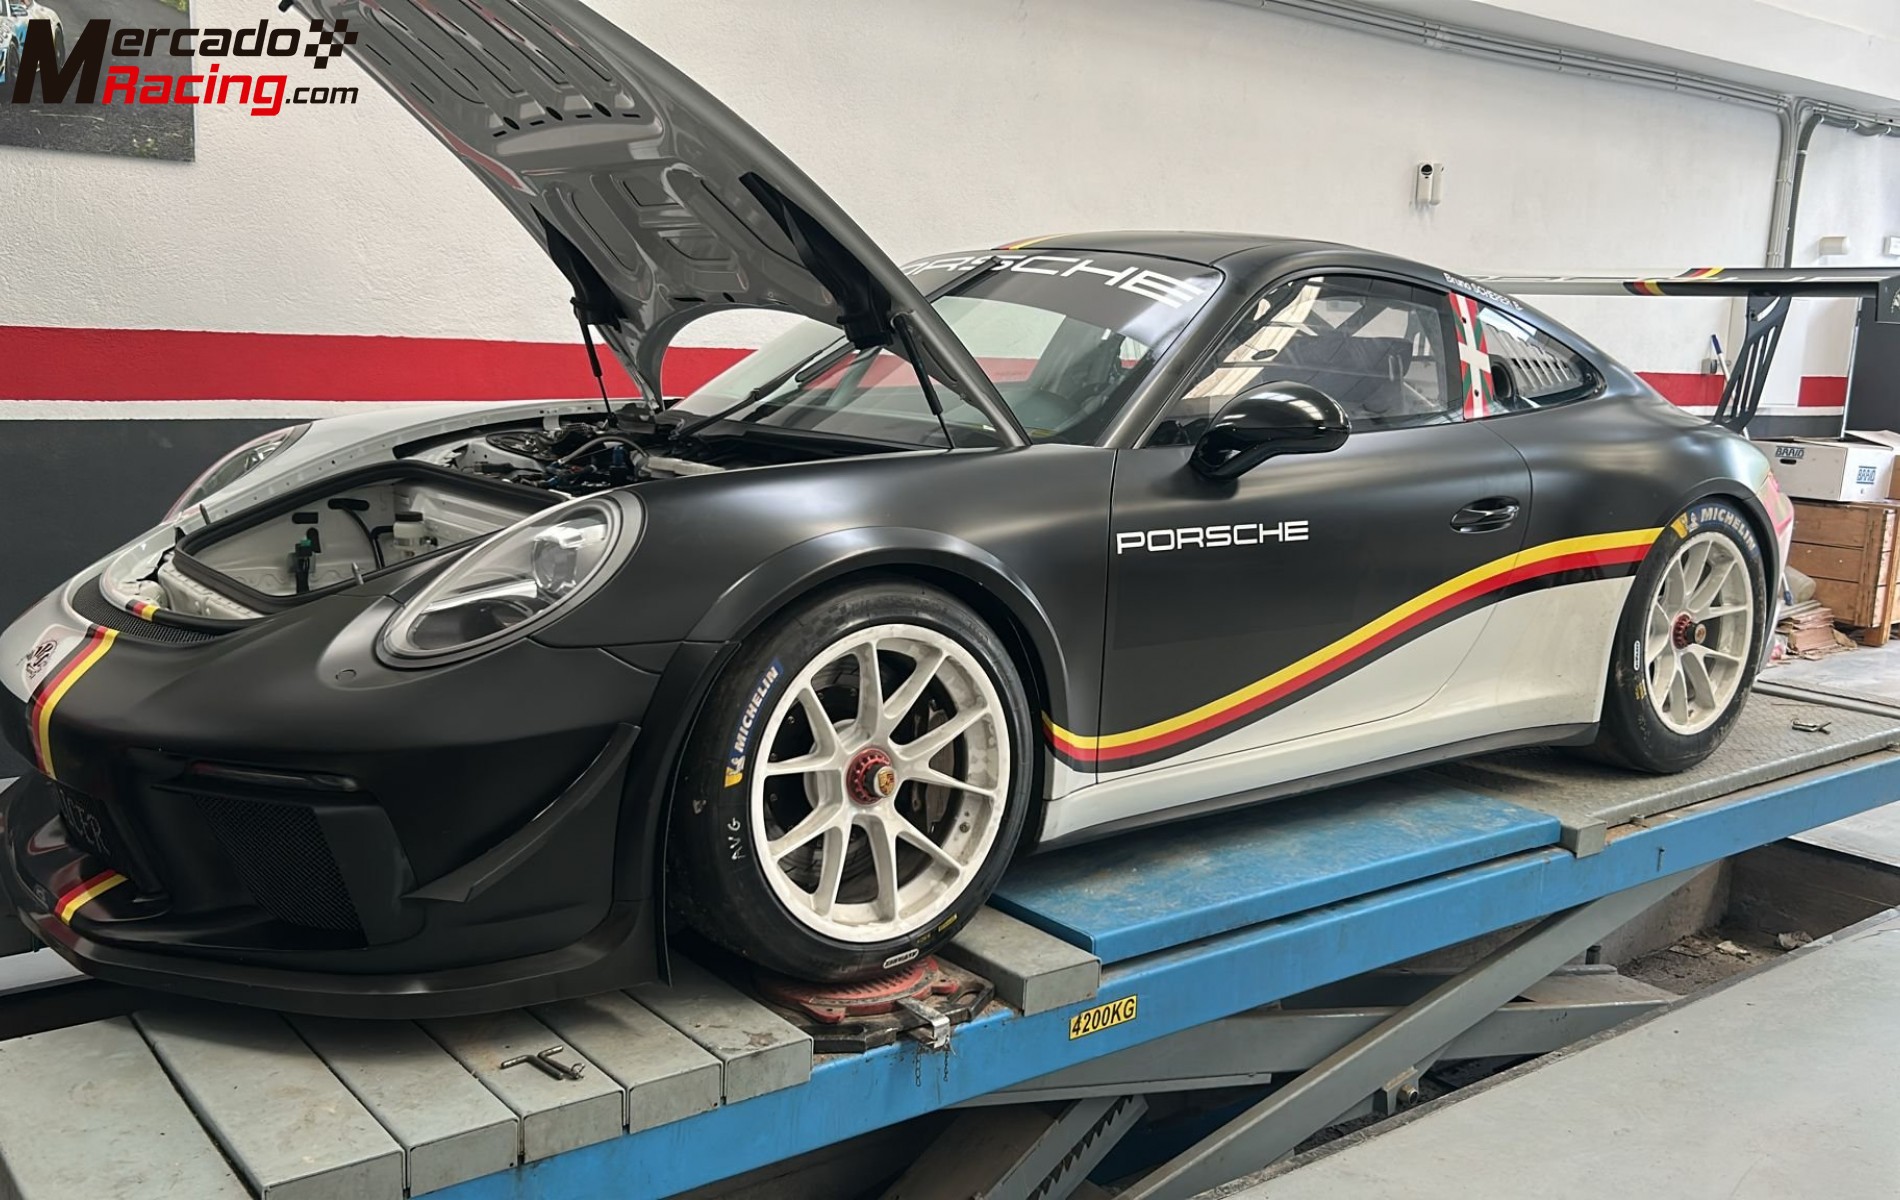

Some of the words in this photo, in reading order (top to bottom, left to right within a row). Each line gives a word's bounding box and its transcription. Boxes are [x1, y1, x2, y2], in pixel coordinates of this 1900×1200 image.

[1116, 520, 1309, 554] PORSCHE
[1700, 507, 1756, 551] MICHELIN
[734, 666, 779, 753] MICHELIN
[1072, 998, 1135, 1035] 4200KG
